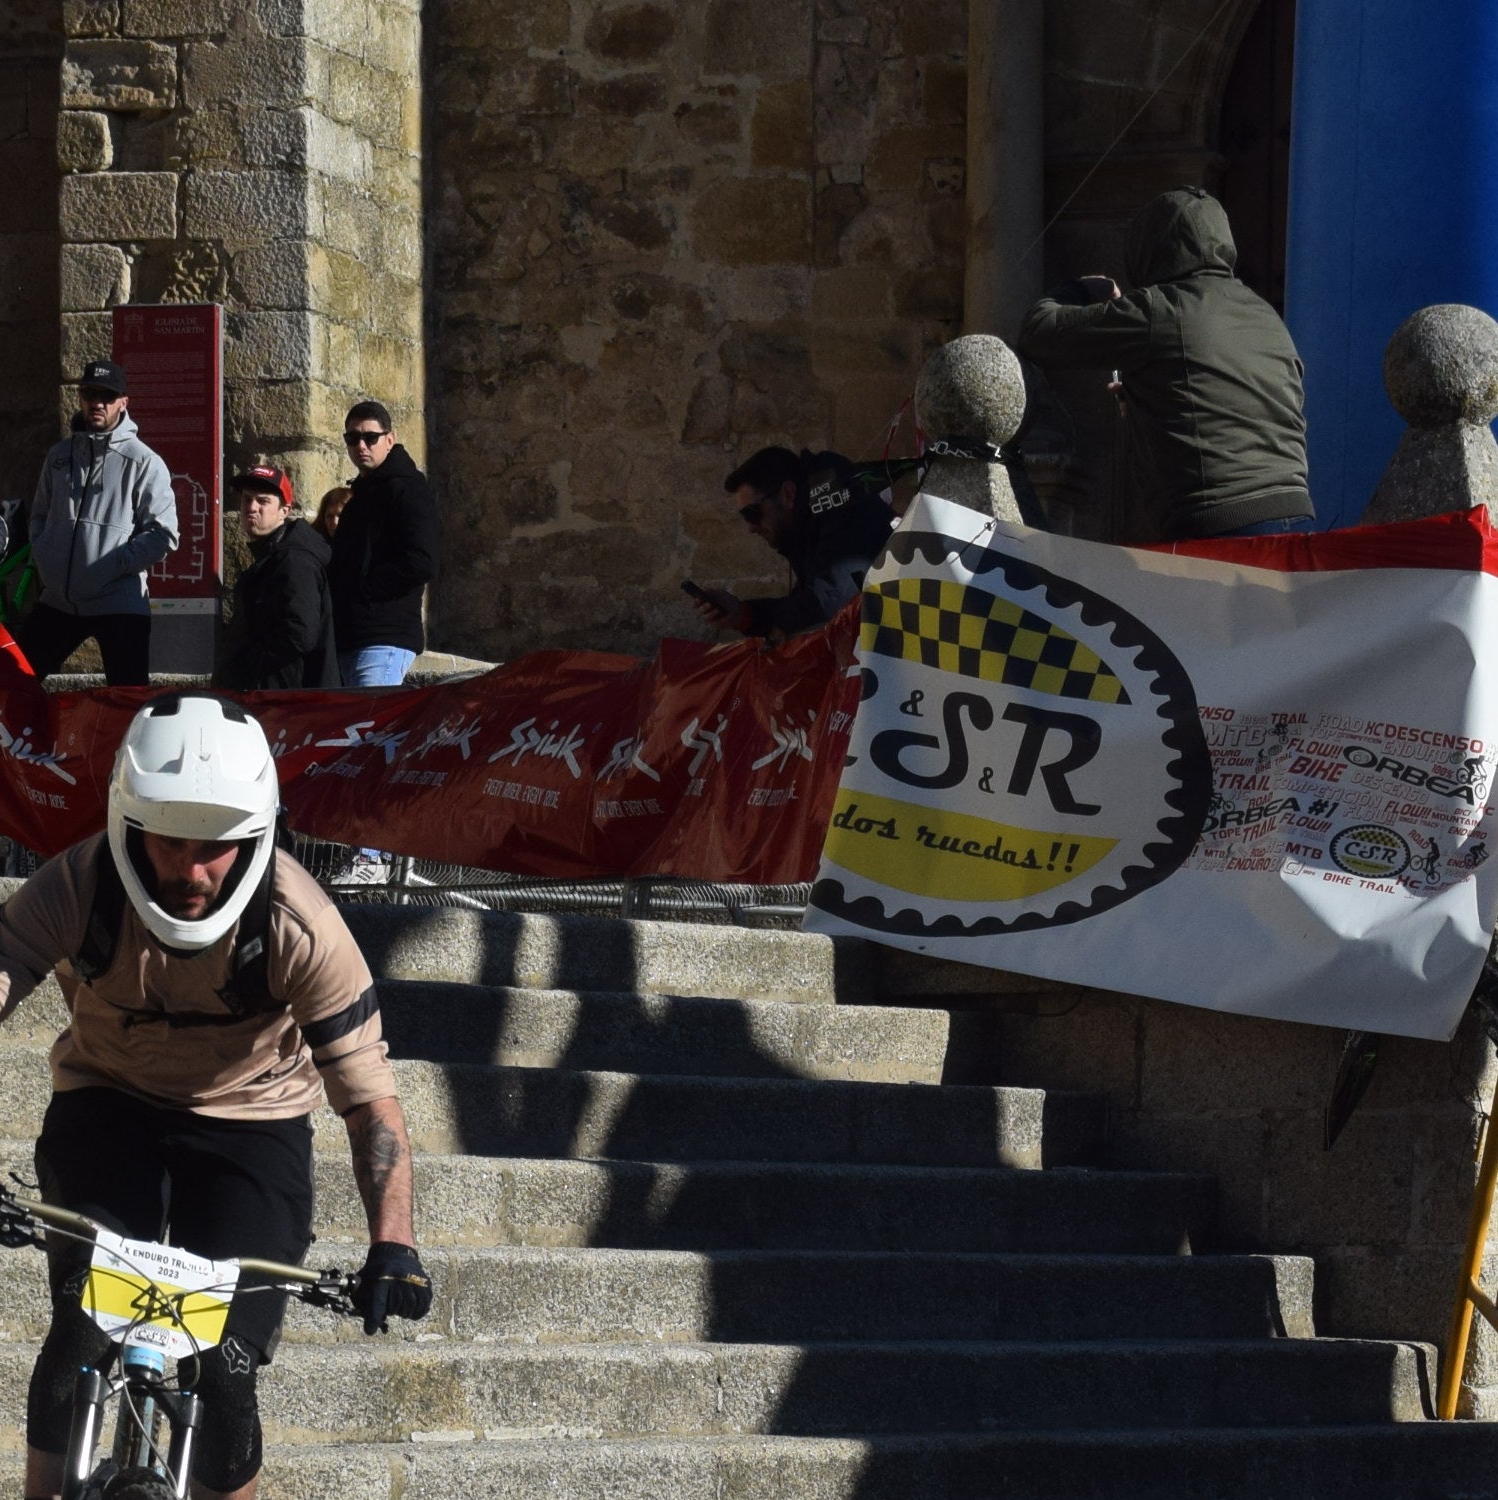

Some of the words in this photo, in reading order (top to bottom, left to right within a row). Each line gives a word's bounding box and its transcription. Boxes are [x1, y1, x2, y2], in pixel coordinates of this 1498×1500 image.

[1271, 713, 1308, 724] TRAIL
[1384, 724, 1484, 753] DESCENSO
[488, 717, 585, 780] Spiuk
[1288, 756, 1349, 783] BIKE
[1343, 746, 1475, 806] ORBEA
[1219, 773, 1271, 791] TRAIL
[1308, 799, 1340, 819] #1
[833, 804, 900, 840] dos
[1432, 812, 1481, 827] MOUNTAIN
[1211, 827, 1241, 840] TOPE
[1408, 829, 1431, 849] ROAD
[1285, 842, 1323, 860] MTB
[1226, 857, 1271, 871] ENDURO
[1323, 872, 1354, 886] BIKE
[1359, 880, 1396, 894] TRAIL
[133, 1249, 169, 1264] ENDURO
[158, 1266, 180, 1279] 2023
